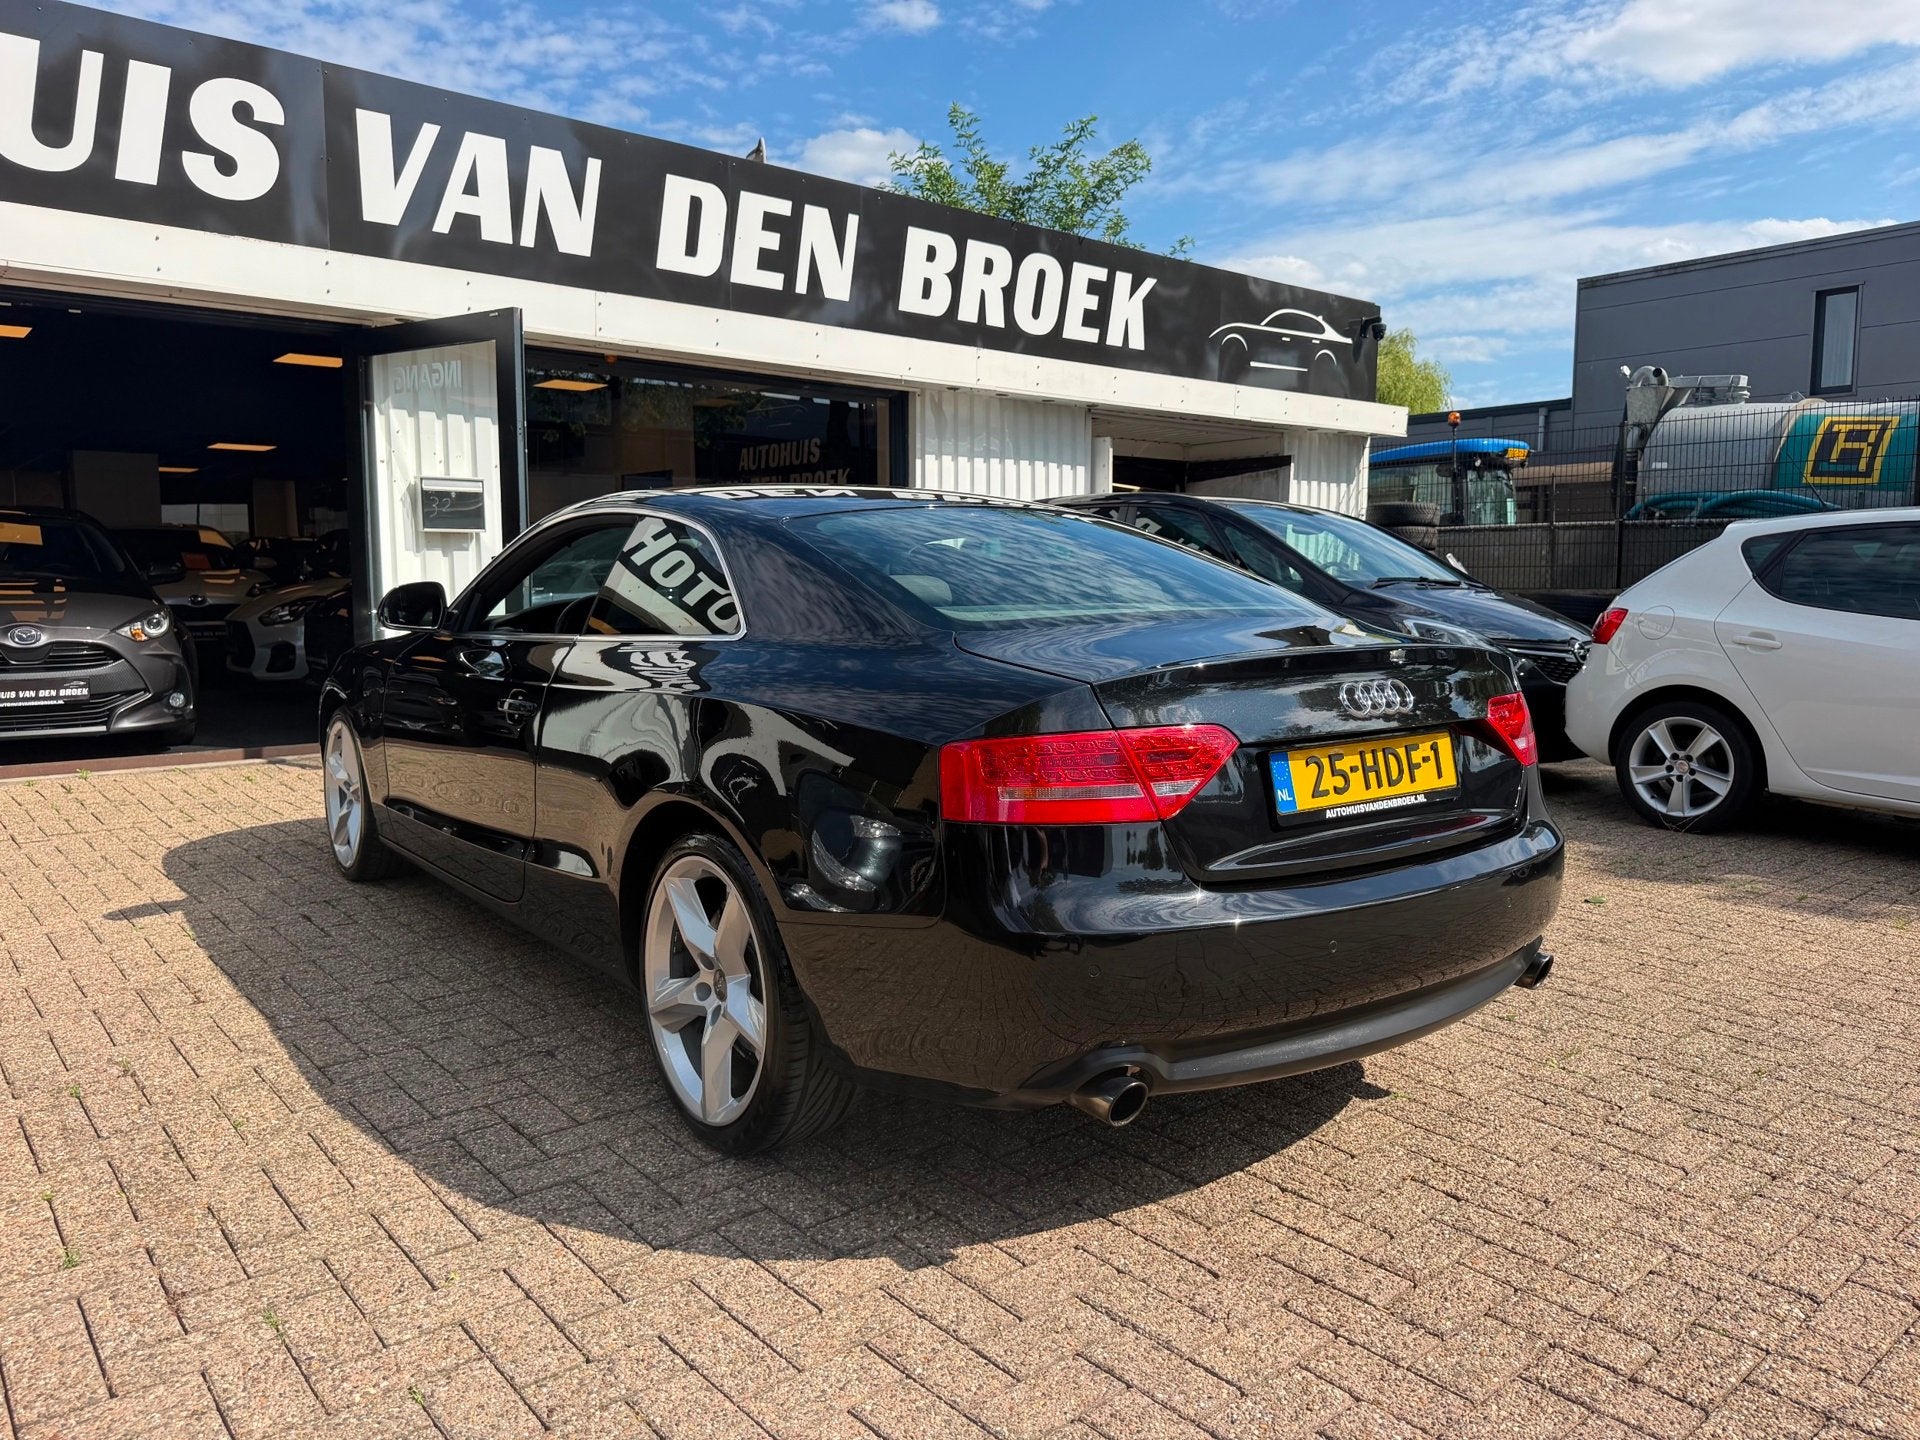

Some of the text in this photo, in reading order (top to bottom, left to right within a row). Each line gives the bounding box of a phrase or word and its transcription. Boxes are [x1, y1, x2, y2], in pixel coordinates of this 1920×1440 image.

[355, 108, 602, 257] VAN
[655, 173, 859, 302] DEN
[898, 226, 1157, 351] BROEK
[739, 436, 822, 472] AUTOHUIS
[429, 496, 451, 518] 32
[19, 690, 36, 698] VAN
[39, 689, 57, 697] DEN
[59, 687, 89, 696] BROEK
[1305, 741, 1443, 799] 25-HDF-1
[1277, 788, 1293, 802] NL
[1325, 793, 1427, 819] AUTOHUISVANDENBROEK.NL
